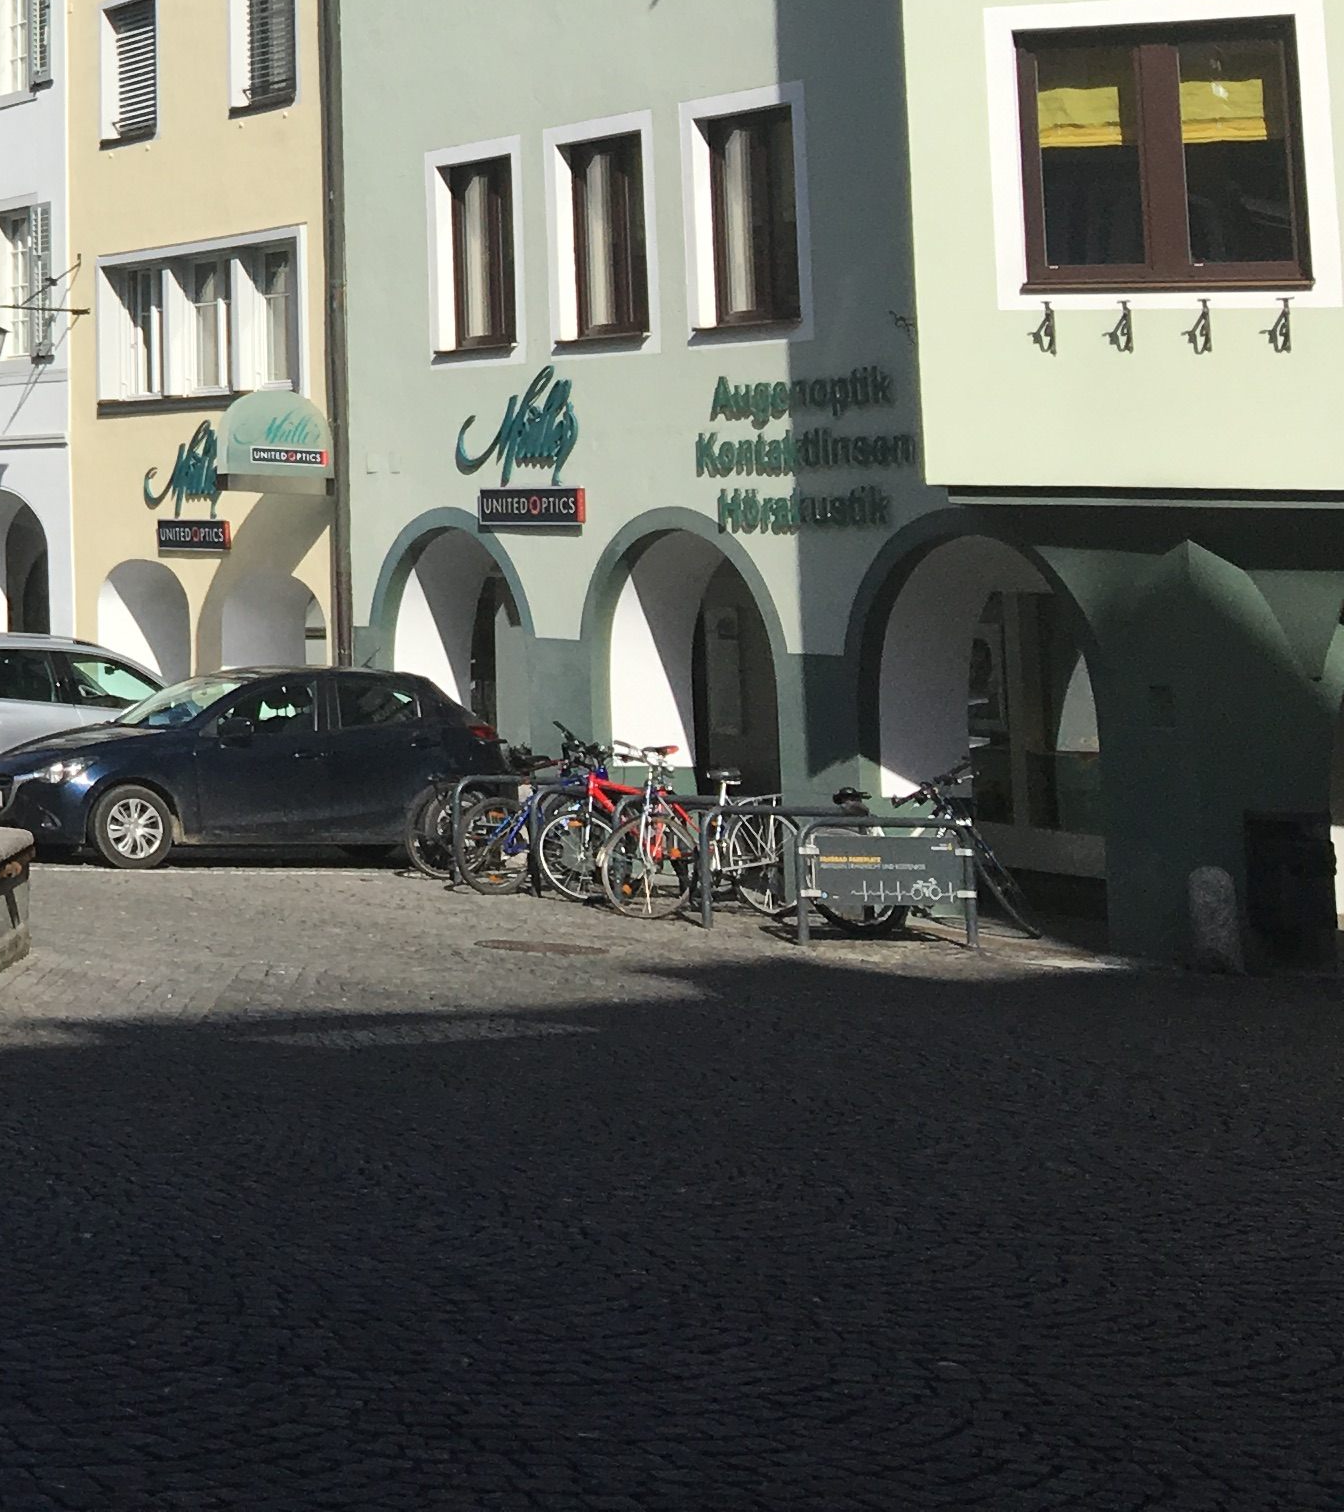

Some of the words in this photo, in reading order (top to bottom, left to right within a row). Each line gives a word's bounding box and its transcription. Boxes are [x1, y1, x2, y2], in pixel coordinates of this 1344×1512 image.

[710, 366, 893, 430] Augenoptik
[696, 427, 916, 477] Kontaktlinsen
[718, 486, 889, 535] Hörakustik
